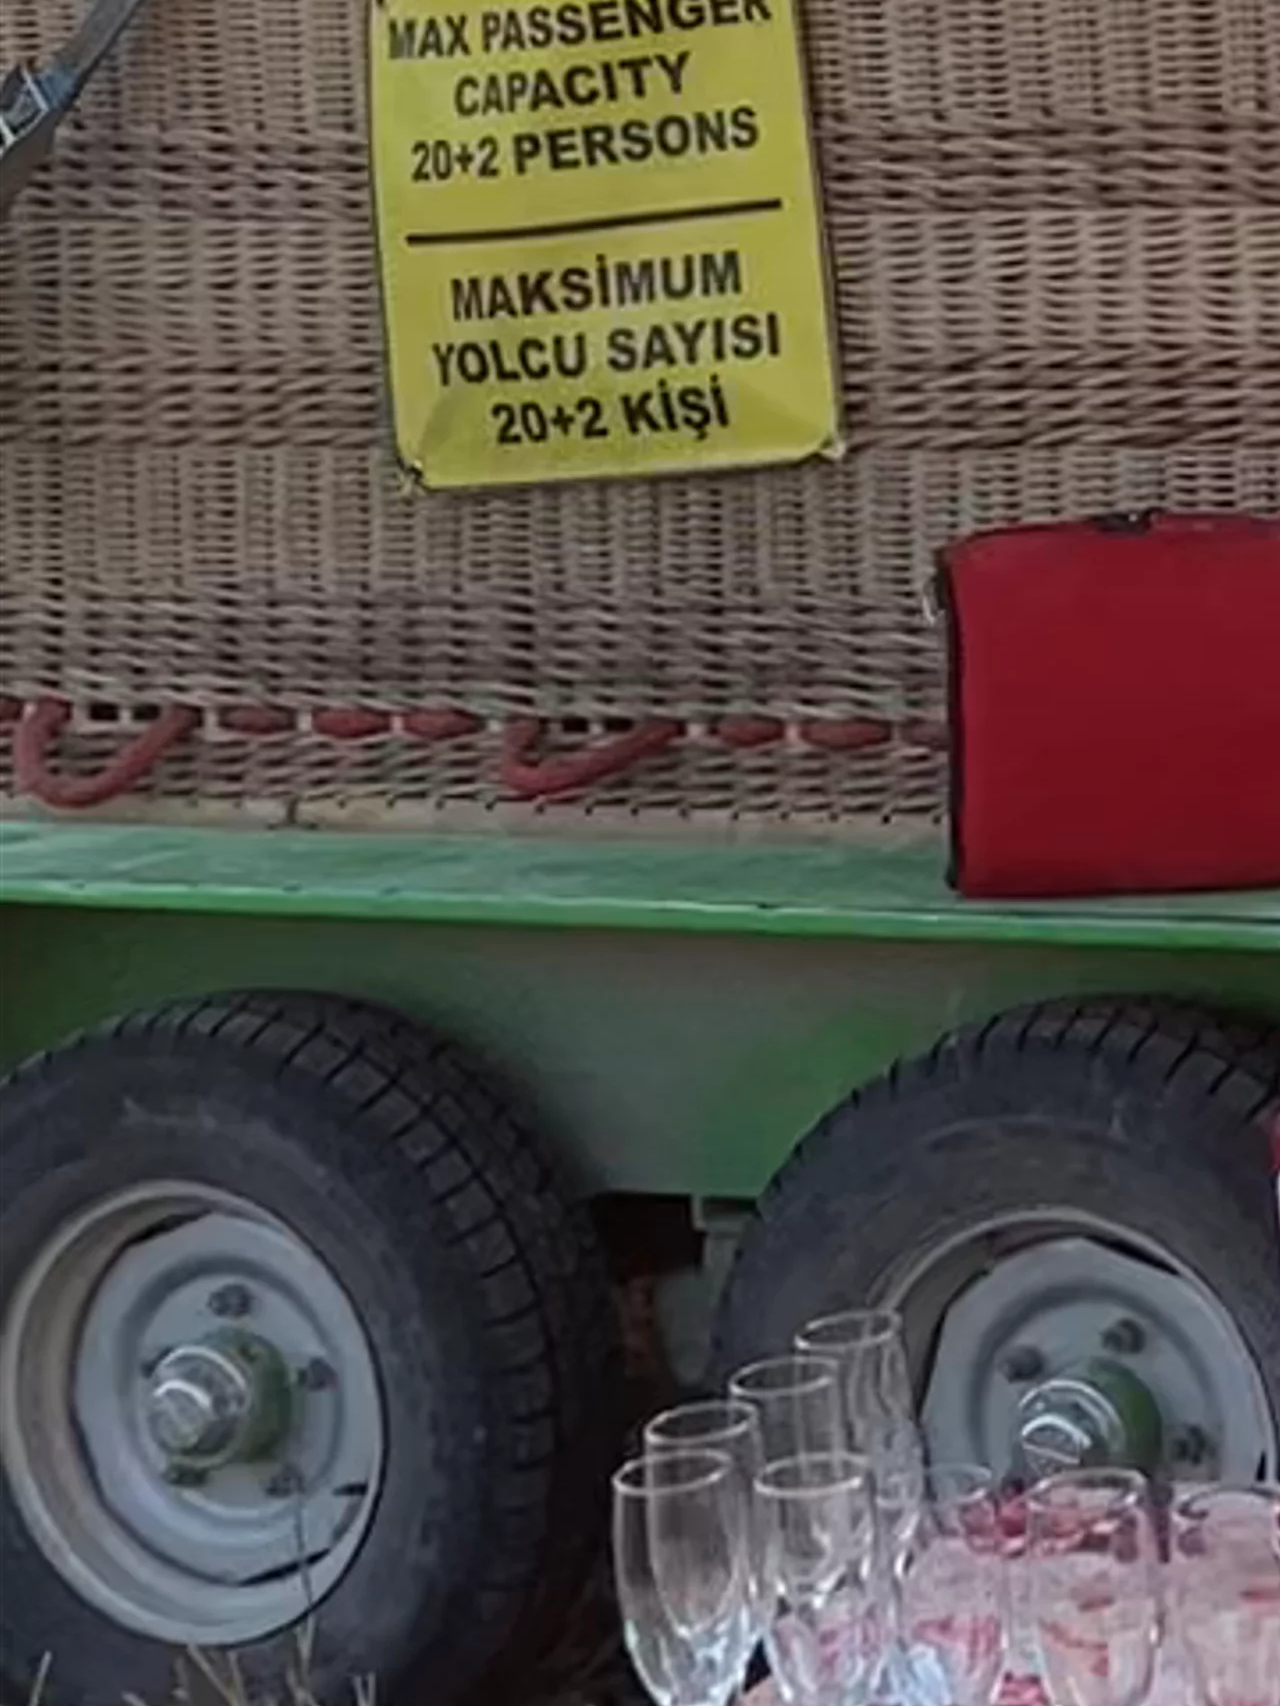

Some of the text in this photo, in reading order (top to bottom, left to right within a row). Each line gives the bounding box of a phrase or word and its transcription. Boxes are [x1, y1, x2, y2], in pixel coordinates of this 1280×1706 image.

[387, 14, 472, 61] MAX
[454, 51, 692, 118] CAPACITY
[410, 107, 760, 184] 20+2 PERSONS
[451, 250, 743, 323] MAKSİMUM
[431, 313, 780, 388] YOLCU SAYISI
[490, 374, 731, 447] 20+2 KİŞİ
